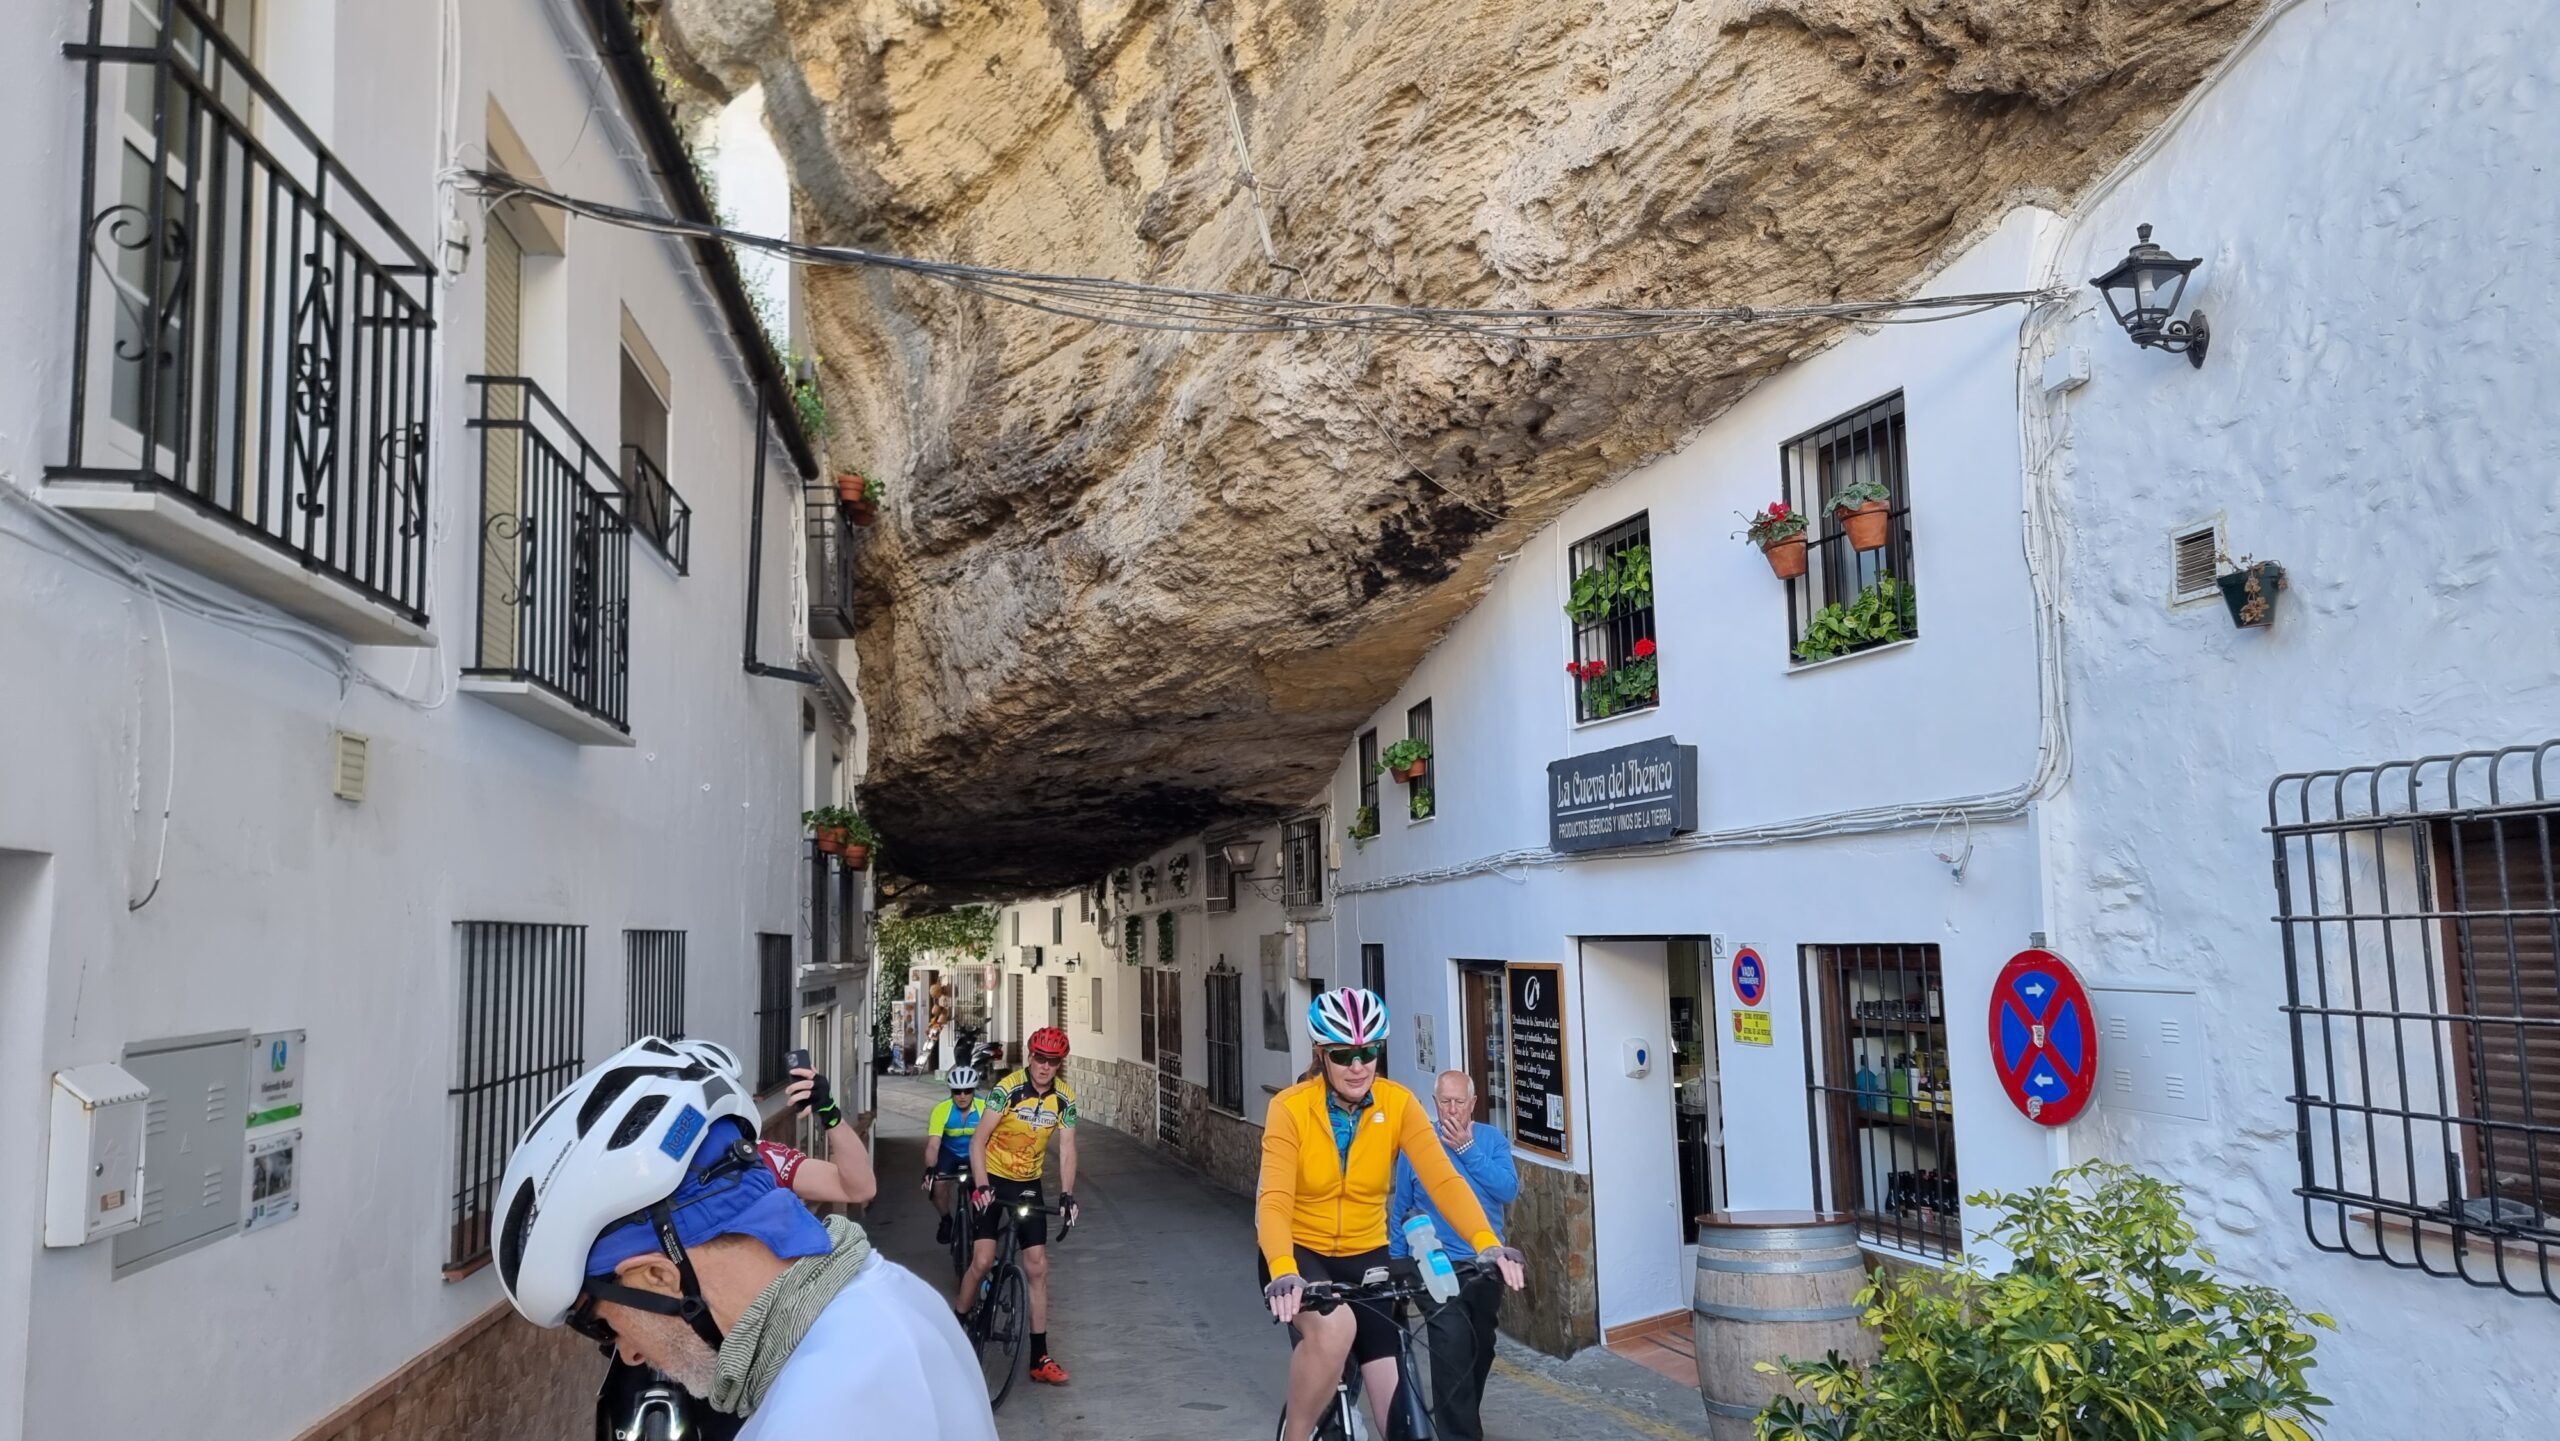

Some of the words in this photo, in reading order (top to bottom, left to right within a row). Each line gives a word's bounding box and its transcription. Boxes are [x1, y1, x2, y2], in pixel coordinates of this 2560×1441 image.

[1557, 774, 1571, 809] La
[1572, 771, 1606, 806] Cueva
[1608, 761, 1626, 799] del
[1628, 756, 1673, 798] Ibérico
[1558, 817, 1588, 839] PRODUCTOS
[1588, 814, 1613, 835] IBÉRICOS
[1612, 815, 1617, 832] Y
[1617, 813, 1634, 831] VINOS
[1634, 811, 1642, 827] DE
[1642, 810, 1651, 827] LA
[1650, 807, 1672, 826] TIERRA
[1714, 937, 1723, 955] 8
[1741, 966, 1754, 978] VADO
